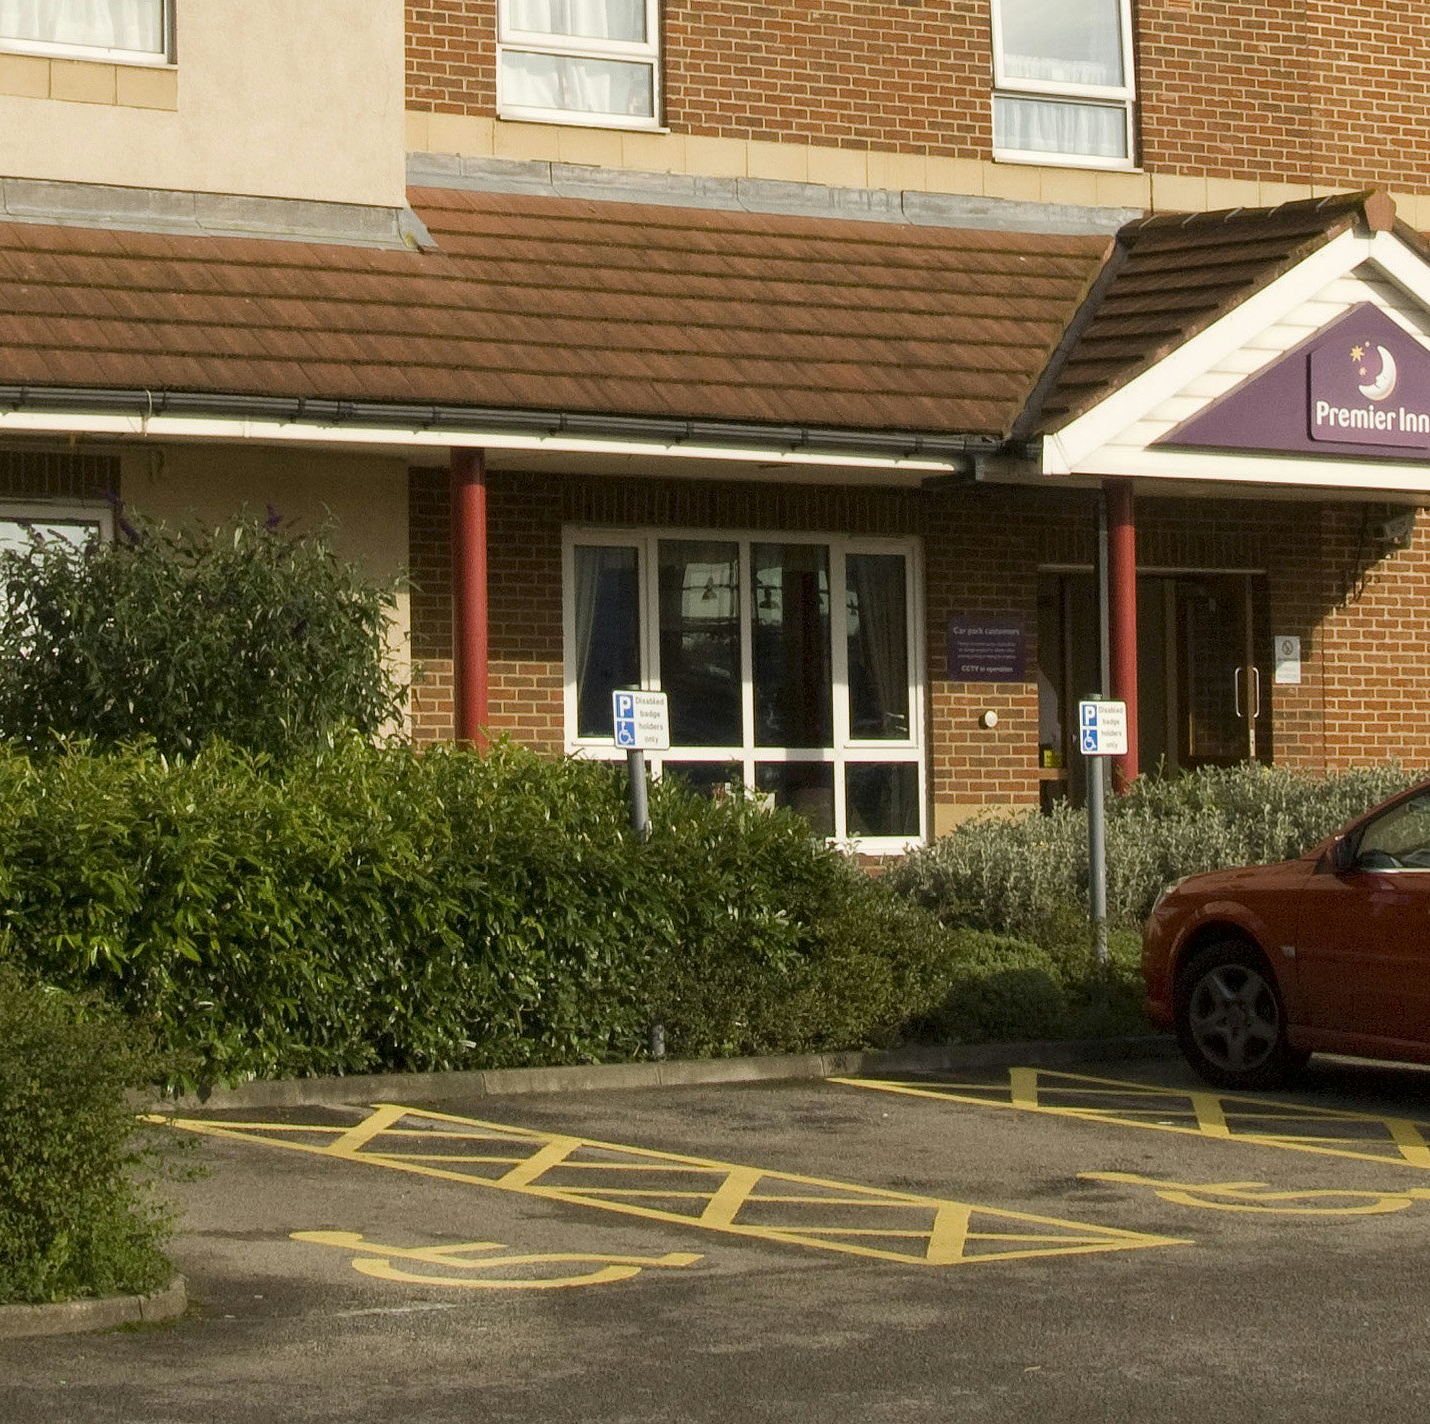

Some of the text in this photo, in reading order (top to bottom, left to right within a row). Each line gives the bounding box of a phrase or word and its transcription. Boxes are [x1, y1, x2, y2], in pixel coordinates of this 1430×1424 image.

[1315, 400, 1430, 433] Premier Inn
[620, 697, 632, 717] P
[636, 697, 665, 705] Disabled
[1085, 707, 1096, 726] P
[645, 736, 659, 744] only
